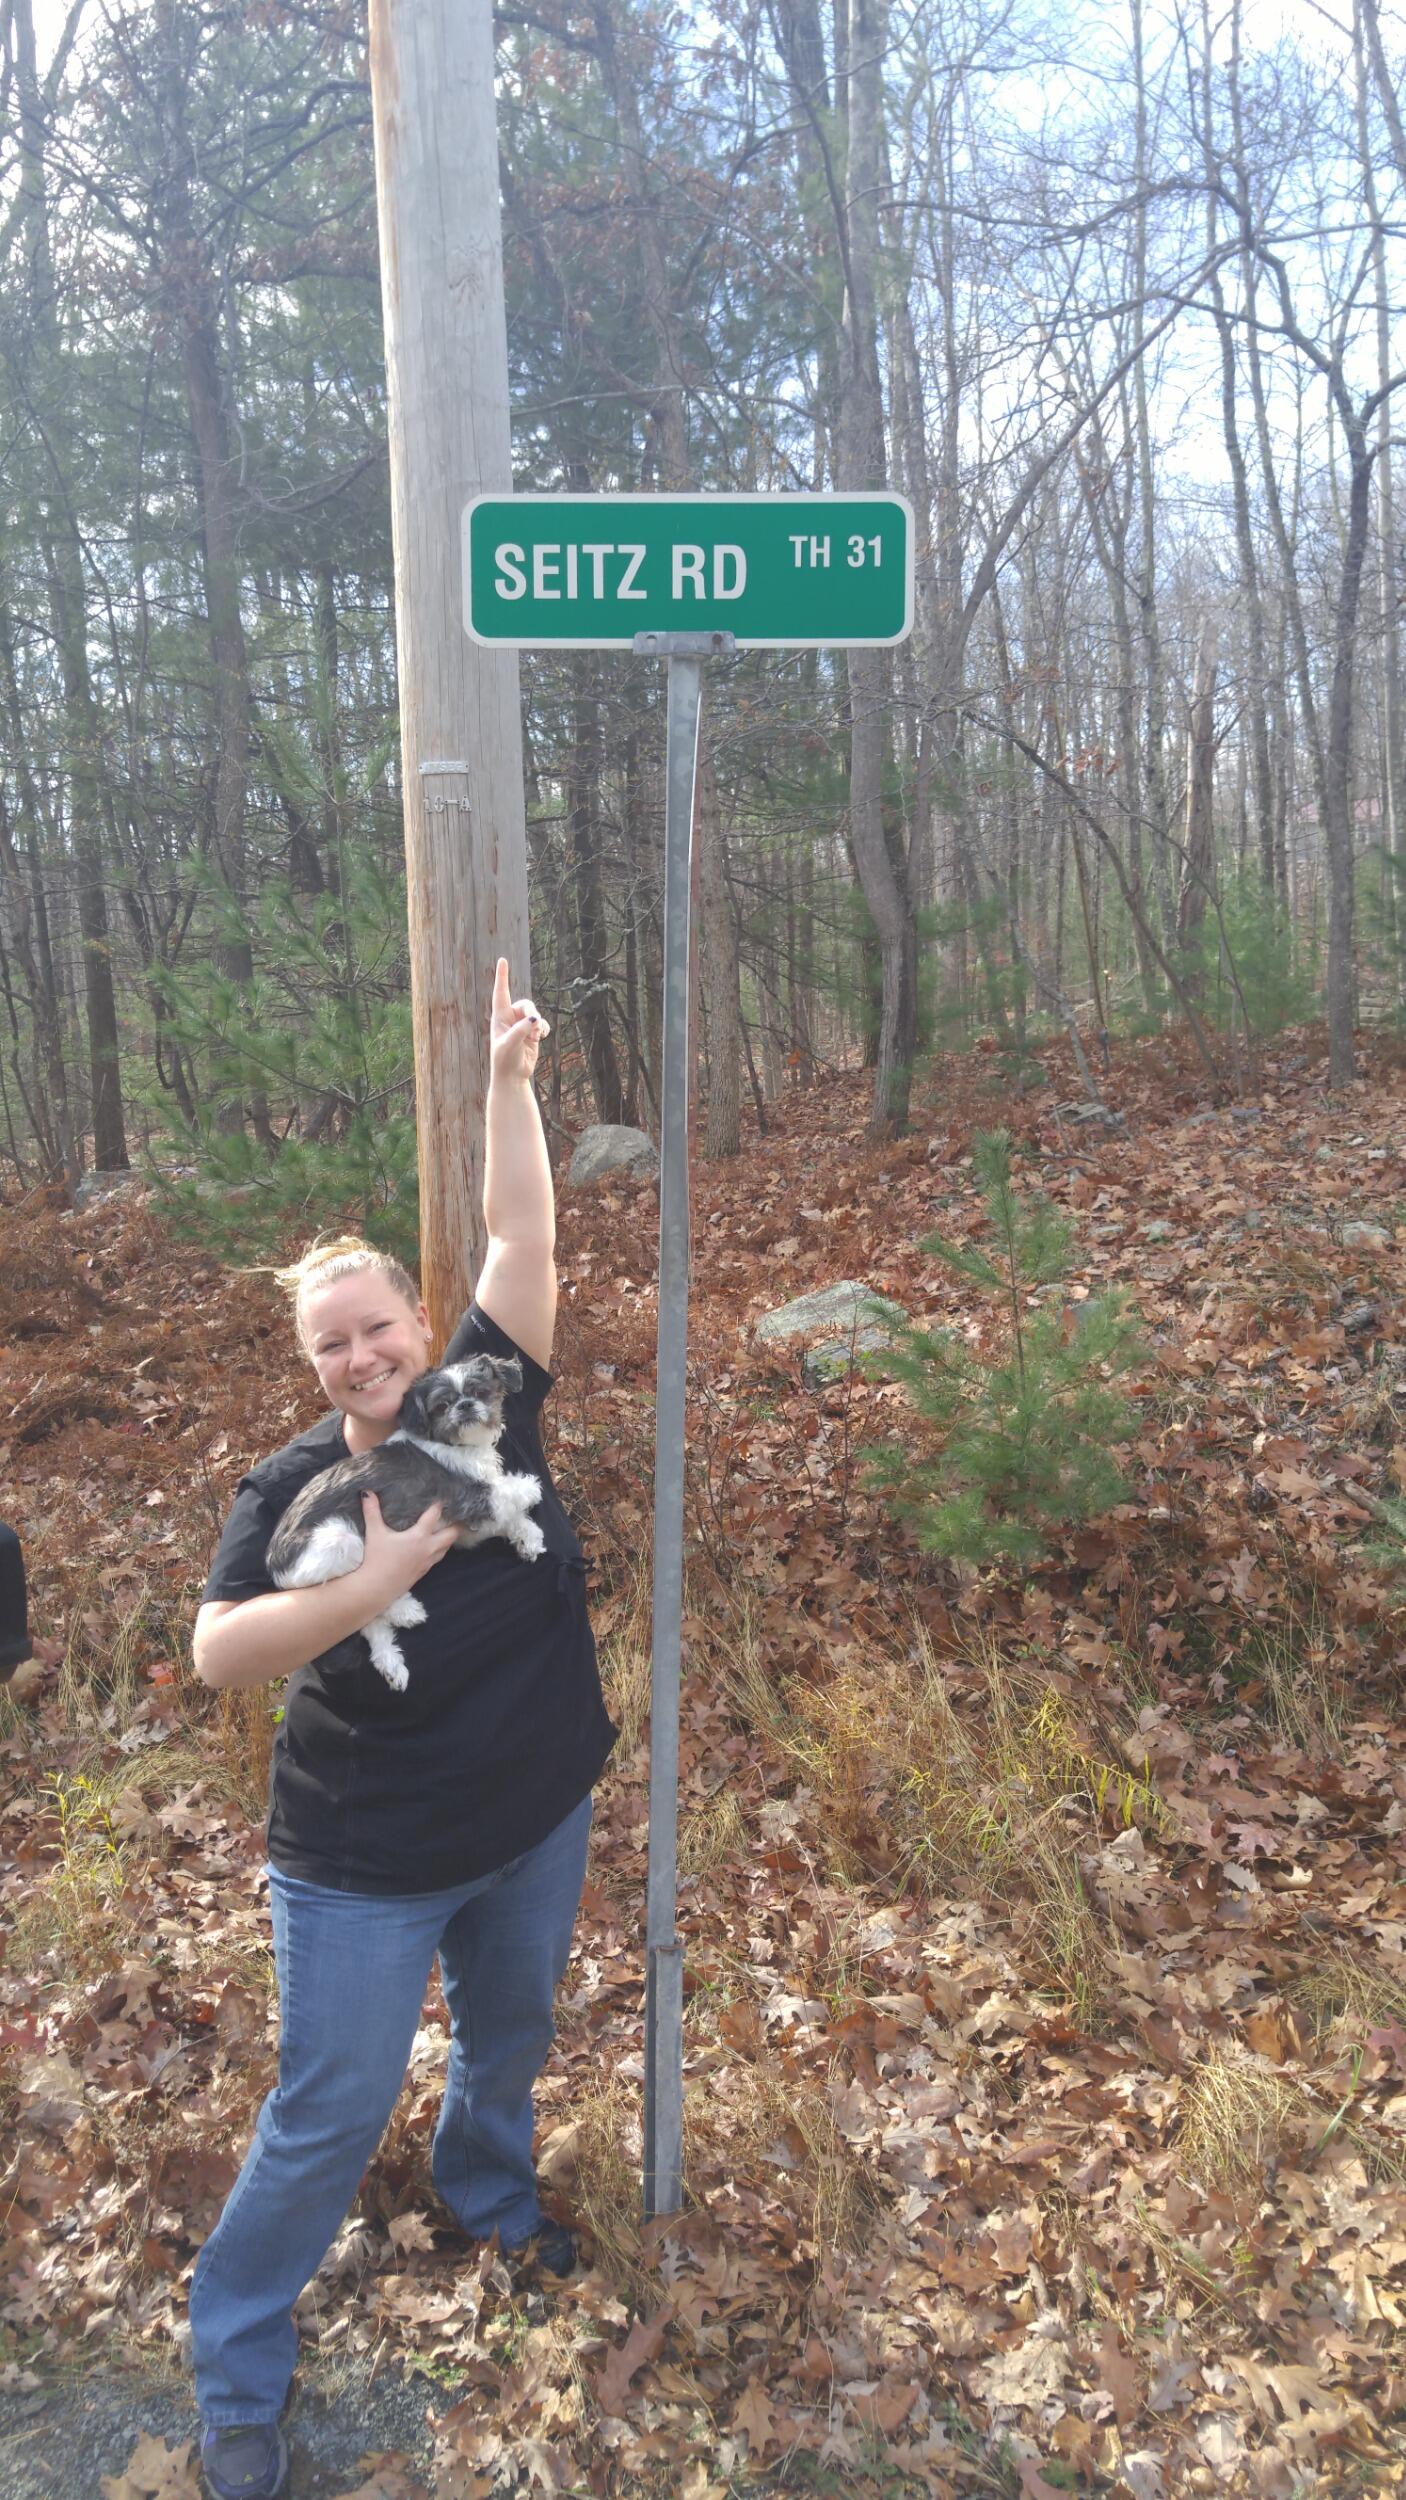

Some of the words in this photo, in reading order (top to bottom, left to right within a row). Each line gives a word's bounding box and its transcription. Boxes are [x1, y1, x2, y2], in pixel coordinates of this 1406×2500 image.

[494, 543, 647, 600] SEITZ
[671, 544, 747, 600] RD
[789, 535, 831, 568] TH
[847, 535, 882, 568] 31
